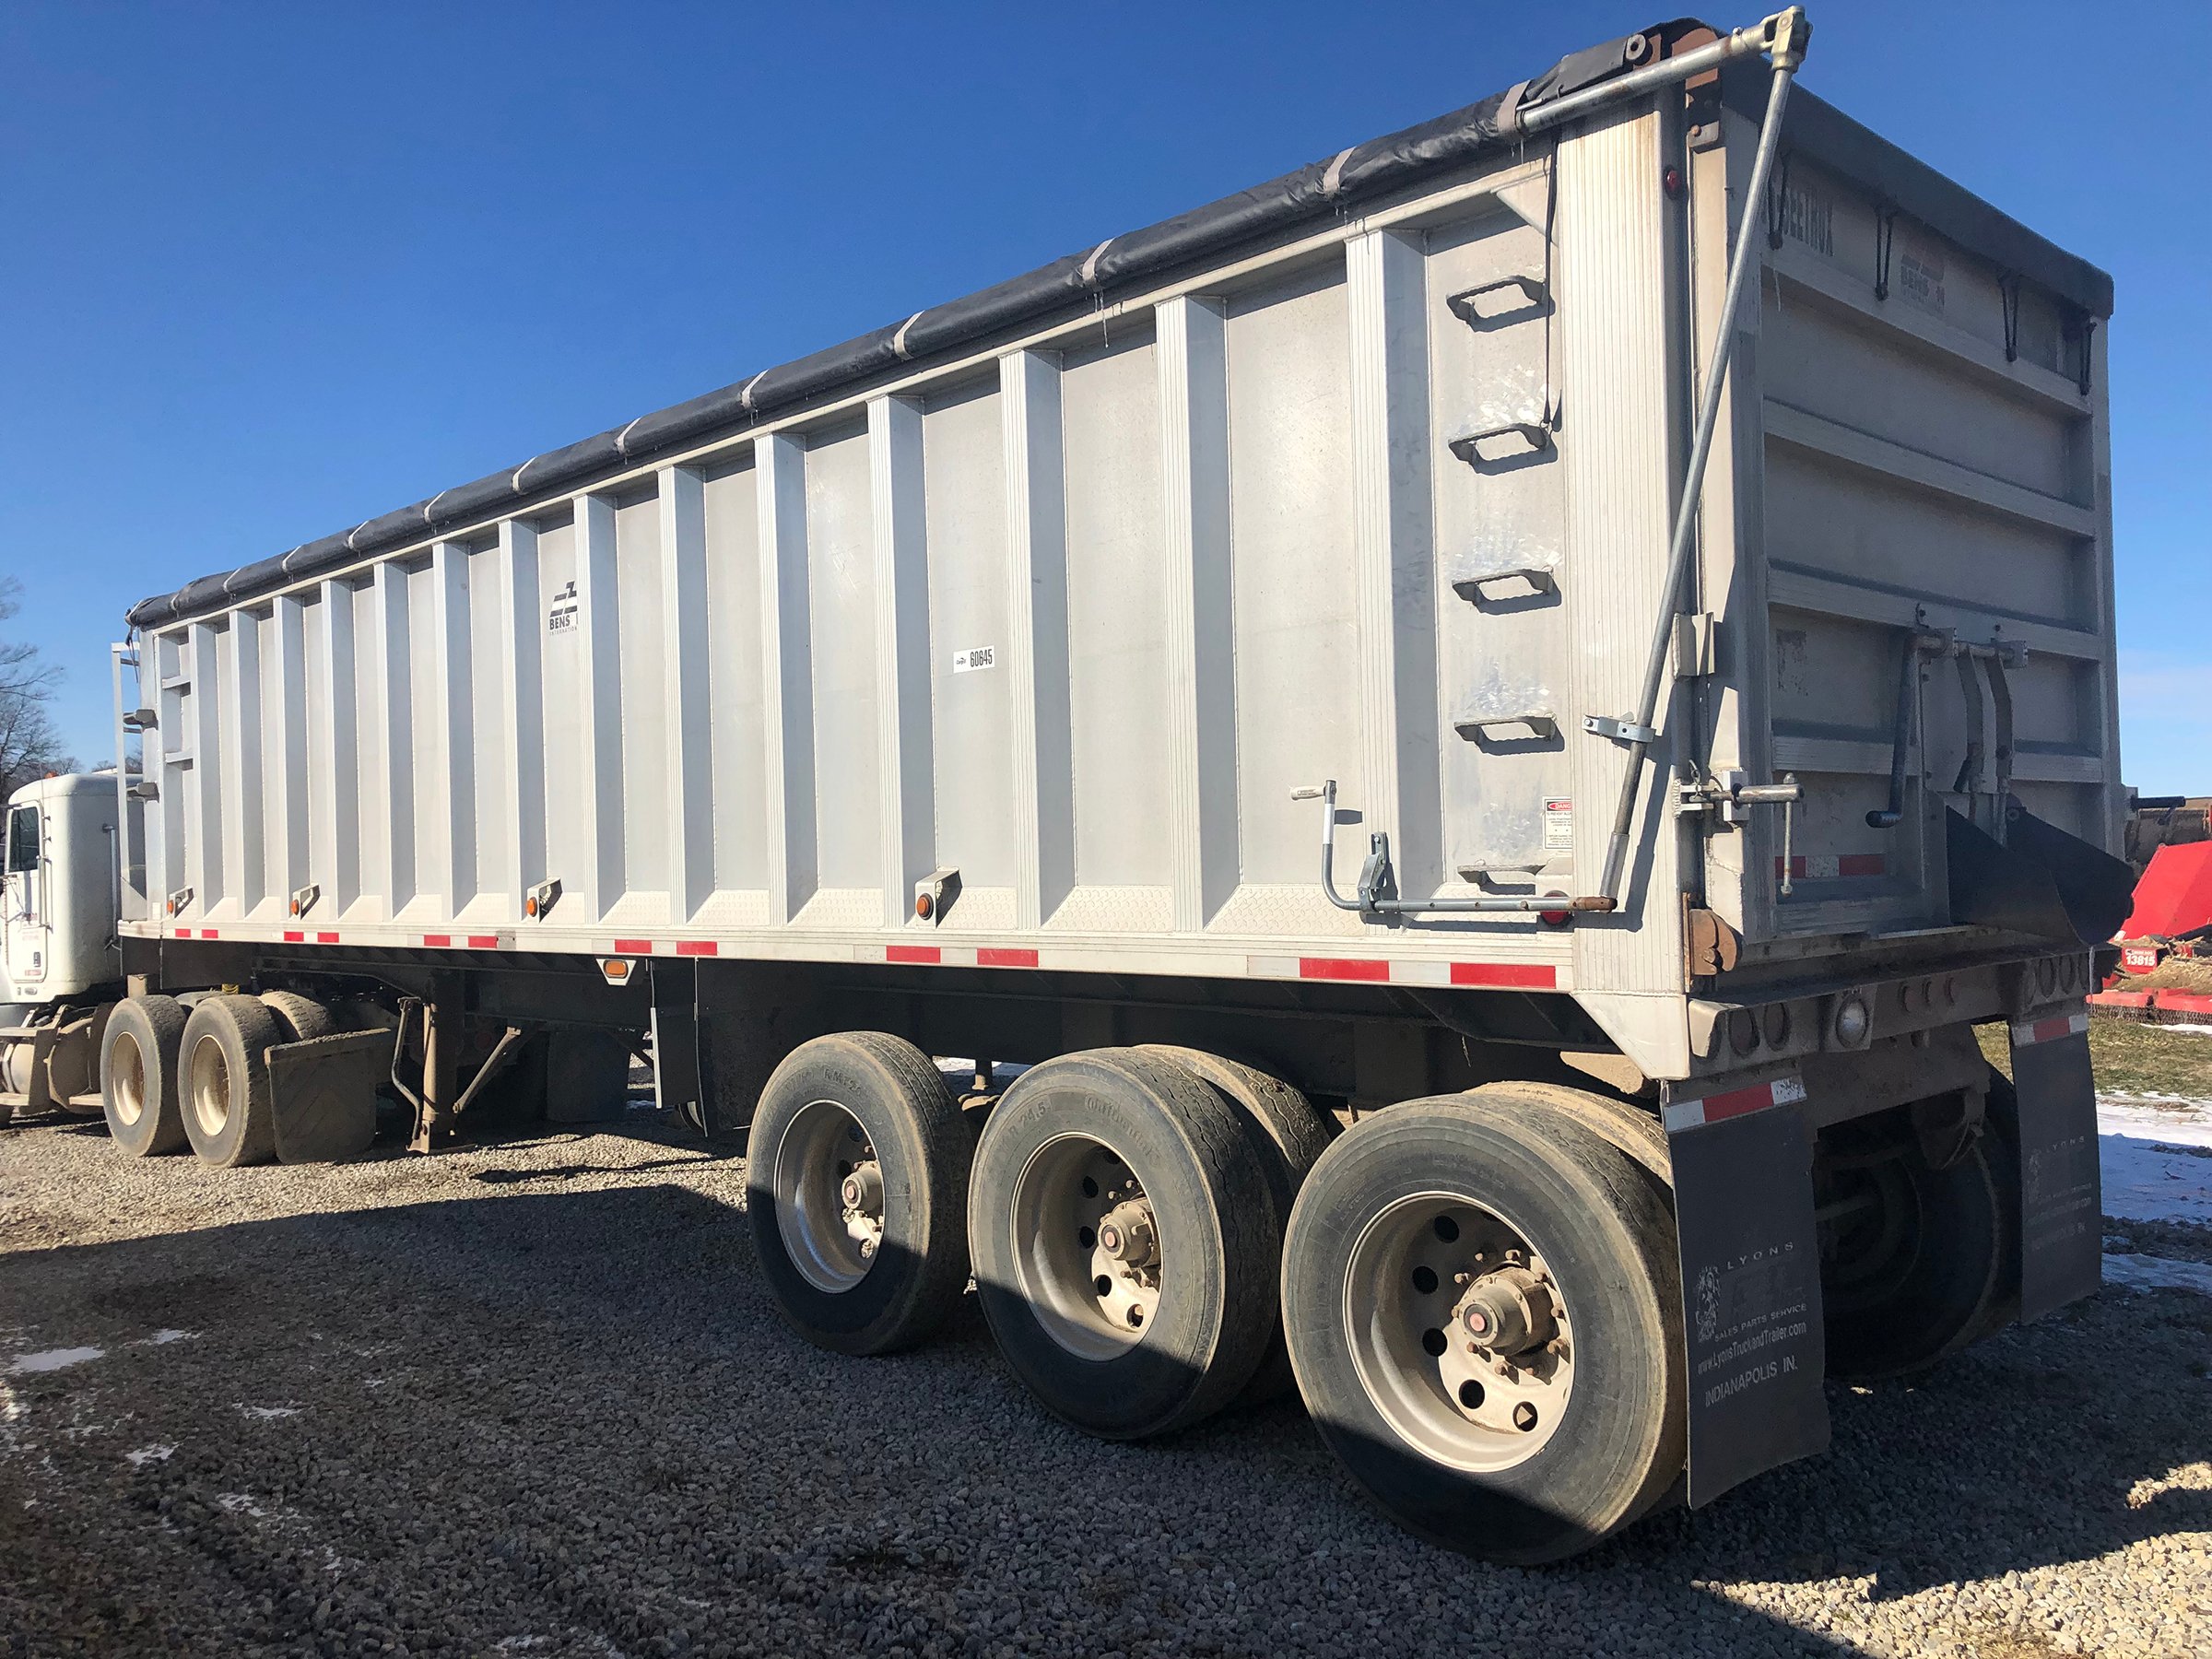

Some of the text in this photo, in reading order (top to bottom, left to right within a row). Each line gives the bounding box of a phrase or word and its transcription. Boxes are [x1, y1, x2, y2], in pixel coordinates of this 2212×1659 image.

[549, 614, 578, 630] BENS
[970, 649, 993, 667] 60645
[2126, 955, 2156, 966] 13815
[1726, 1241, 1794, 1270] LYONS
[1714, 1302, 1807, 1343] SALES PARTS SERVICE
[1705, 1360, 1778, 1408] INDIANAPOLIS
